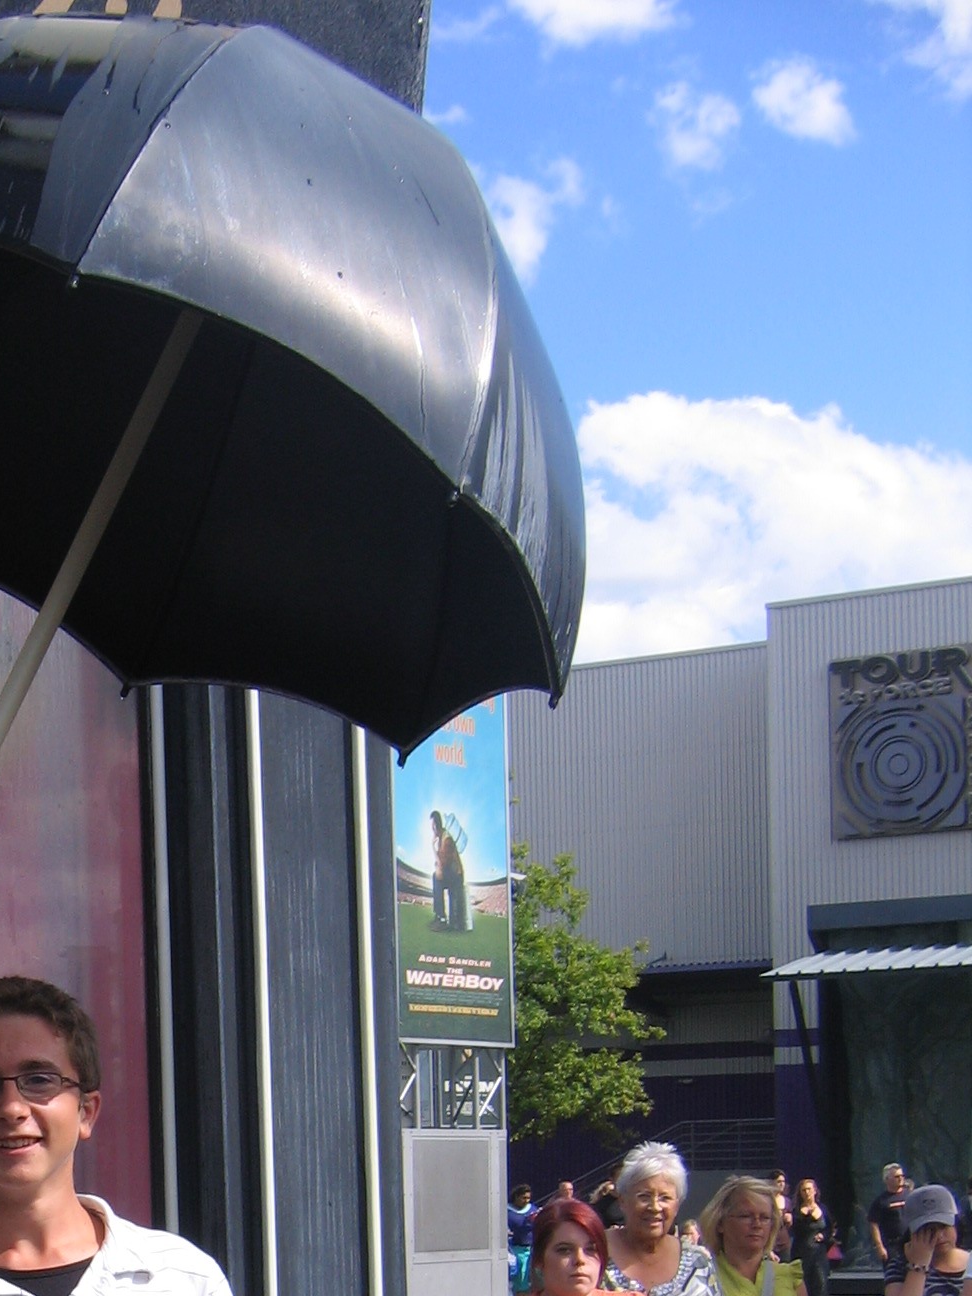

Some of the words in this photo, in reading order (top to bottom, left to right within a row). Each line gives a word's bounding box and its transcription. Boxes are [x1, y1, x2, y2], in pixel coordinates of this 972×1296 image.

[829, 647, 972, 692] TOUR
[418, 954, 446, 964] ADAM
[448, 956, 492, 968] SANDLER
[405, 969, 505, 991] WATERBOY
[446, 967, 464, 975] THE
